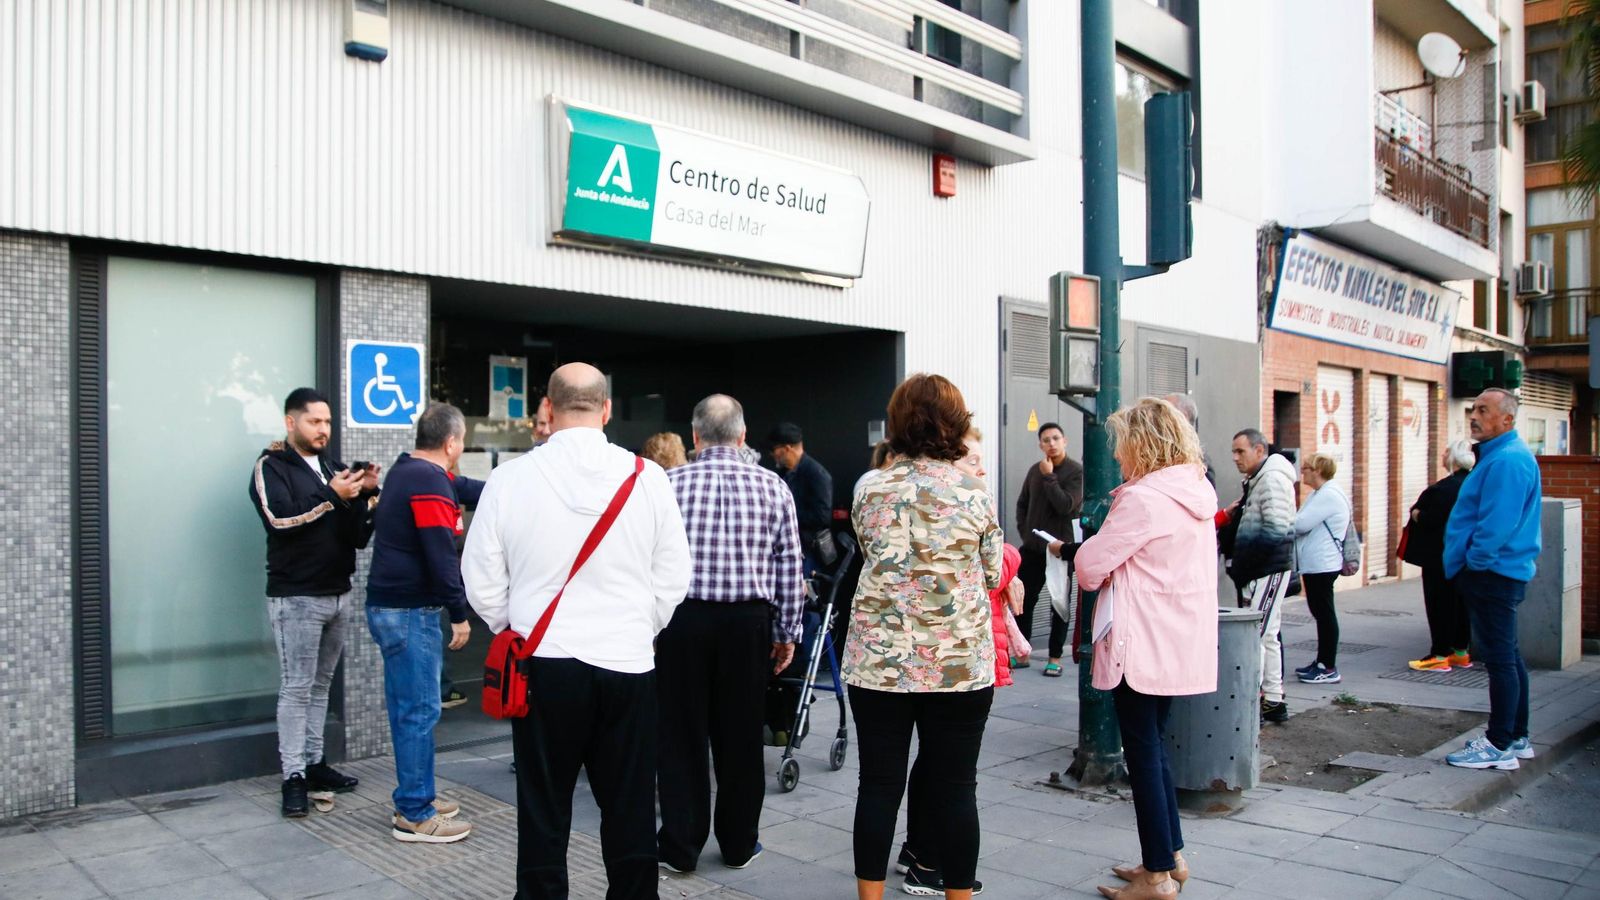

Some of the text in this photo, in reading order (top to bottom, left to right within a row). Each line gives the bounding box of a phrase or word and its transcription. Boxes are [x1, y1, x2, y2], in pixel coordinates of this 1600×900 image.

[574, 187, 598, 201] Junta
[599, 191, 610, 203] de
[669, 160, 826, 214] Centro de Salud
[664, 201, 766, 237] Casa del Mar
[1285, 245, 1343, 293] EFECTOS
[1343, 265, 1388, 307] NAVALES
[1387, 281, 1408, 314] DEL
[1407, 289, 1425, 320] SUR
[1278, 299, 1324, 325] SUMINISTROS
[1328, 311, 1369, 336] INDUSTRIALES
